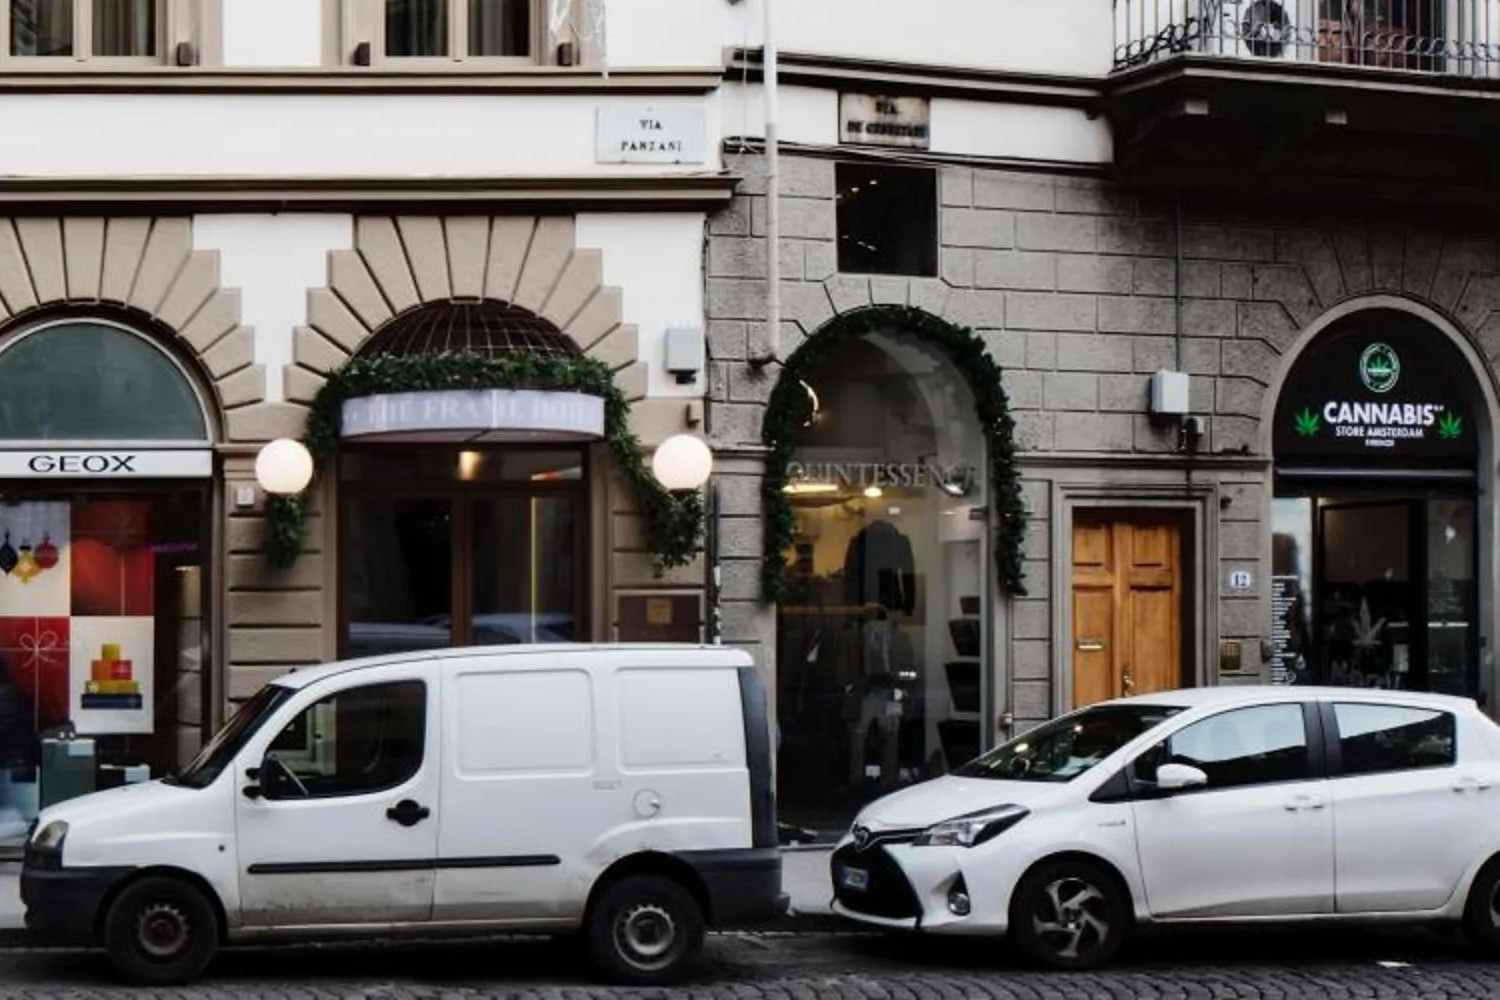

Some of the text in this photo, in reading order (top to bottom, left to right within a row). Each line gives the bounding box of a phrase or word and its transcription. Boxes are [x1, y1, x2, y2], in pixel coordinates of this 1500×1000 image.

[639, 119, 662, 130] VIA
[620, 140, 682, 153] PANZANI
[1323, 401, 1435, 426] CANNABIS
[1335, 426, 1424, 438] STORE AMSTERDAM
[28, 455, 136, 473] GEOX
